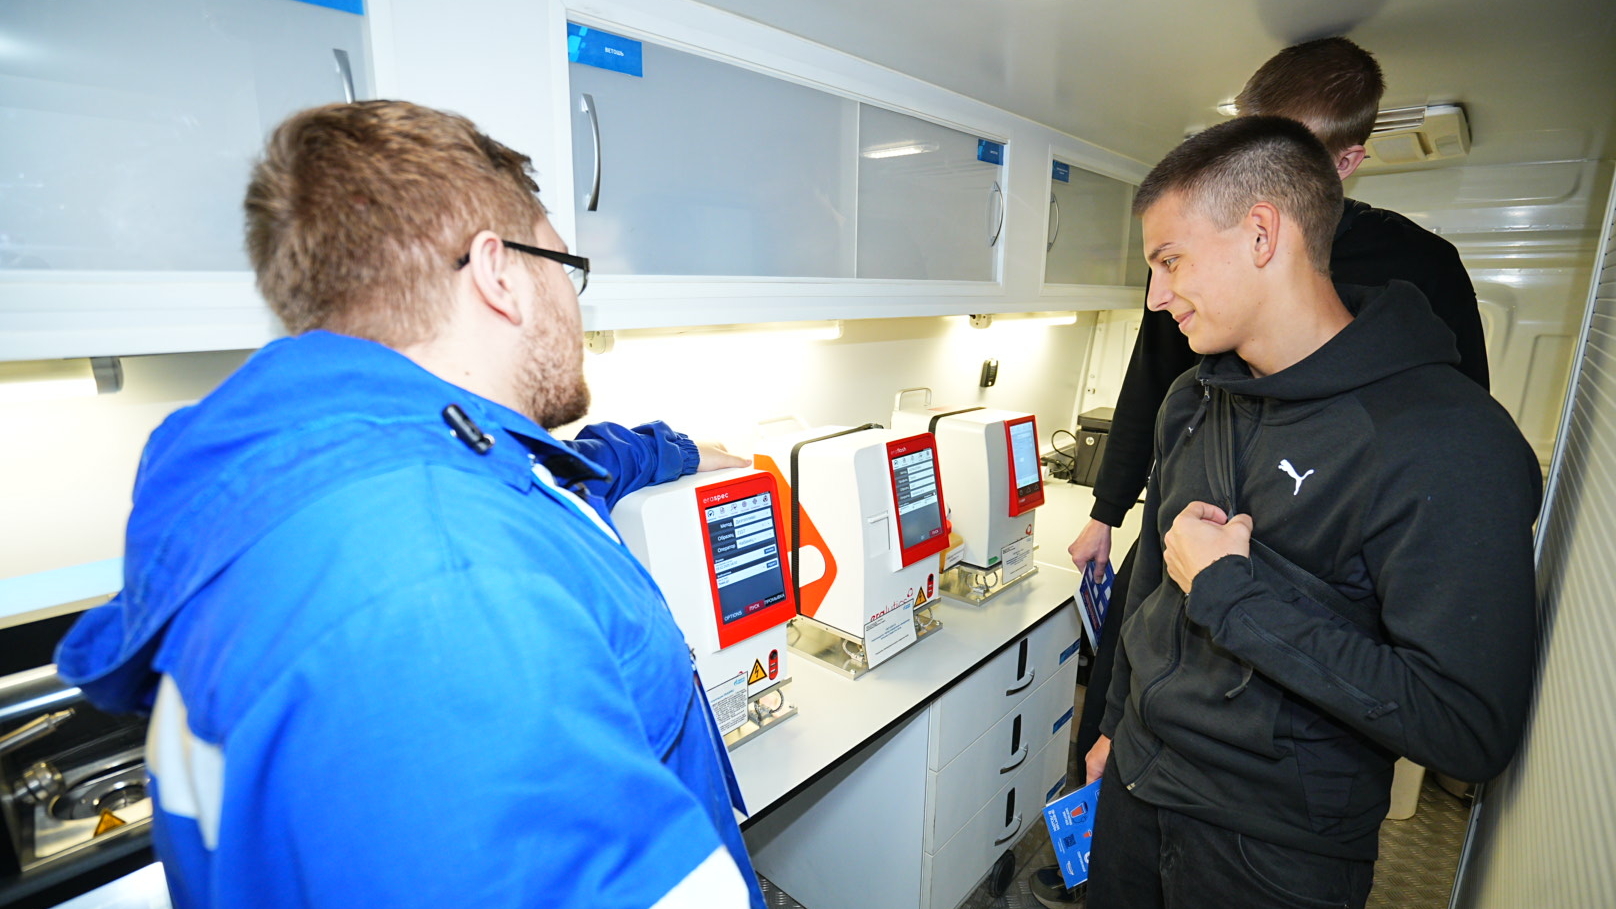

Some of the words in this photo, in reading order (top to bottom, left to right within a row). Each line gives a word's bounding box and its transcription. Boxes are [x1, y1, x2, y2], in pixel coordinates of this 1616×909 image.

[702, 492, 729, 504] eraspec
[720, 521, 733, 529] Метод
[717, 532, 735, 541] Образец
[764, 593, 786, 605] ПРОМЫВКА
[748, 602, 760, 611] ПУСК
[723, 610, 743, 622] OPTIONS
